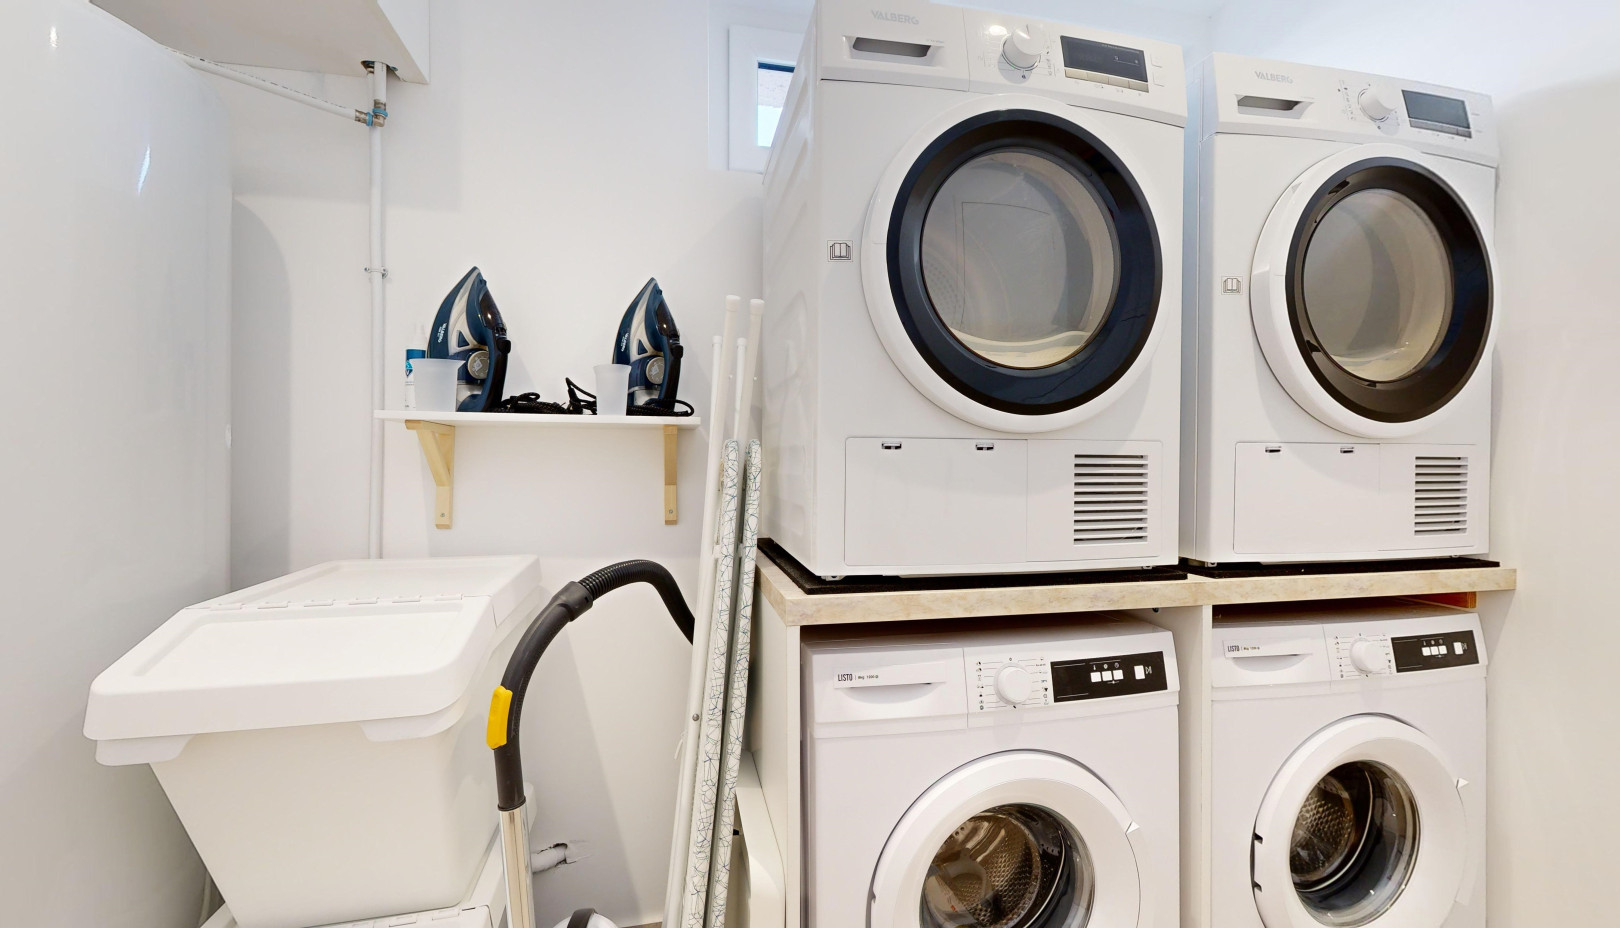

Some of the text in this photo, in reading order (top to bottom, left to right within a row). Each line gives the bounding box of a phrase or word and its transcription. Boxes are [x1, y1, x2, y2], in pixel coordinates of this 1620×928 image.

[871, 9, 919, 26] VALBERG
[1254, 71, 1293, 84] VALBERG
[838, 673, 853, 682] LISTO
